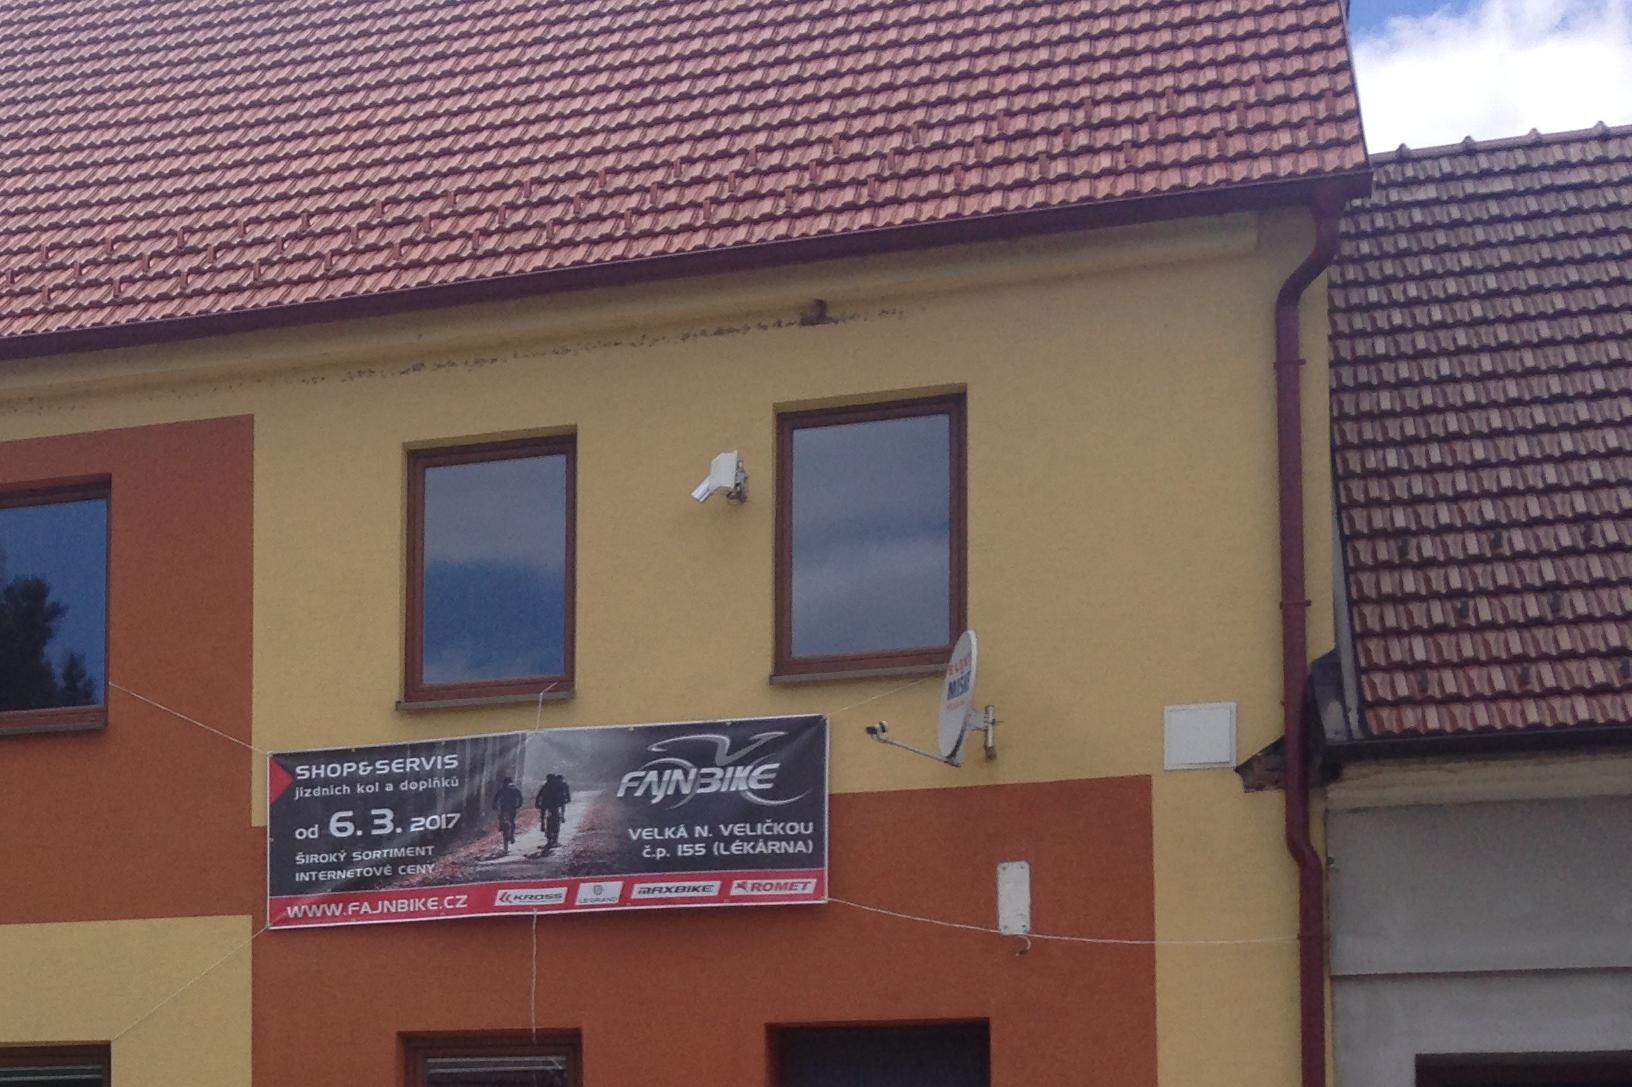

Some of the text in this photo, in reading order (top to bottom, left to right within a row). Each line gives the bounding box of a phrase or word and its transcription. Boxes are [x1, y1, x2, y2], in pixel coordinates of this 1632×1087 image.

[295, 754, 459, 780] SHOP&SERVIS
[294, 776, 460, 800] jízdních kol a doplňků
[616, 762, 781, 805] FAJNBIKE
[295, 824, 319, 840] od
[409, 813, 461, 832] 2017
[628, 819, 814, 841] VELKÁ N. VELIČKOU
[295, 845, 435, 865] ŠIROKÝ SORTIMENT
[642, 839, 814, 860] č.p. 155 (LÉKÁRNA)
[295, 863, 436, 882] INTERNETOVÉ CENY
[513, 892, 562, 901] KROSS
[637, 883, 715, 895] MAXBIKE
[750, 881, 812, 892] ROMET
[287, 895, 468, 919] WWW.FAJNBIKE.CZ
